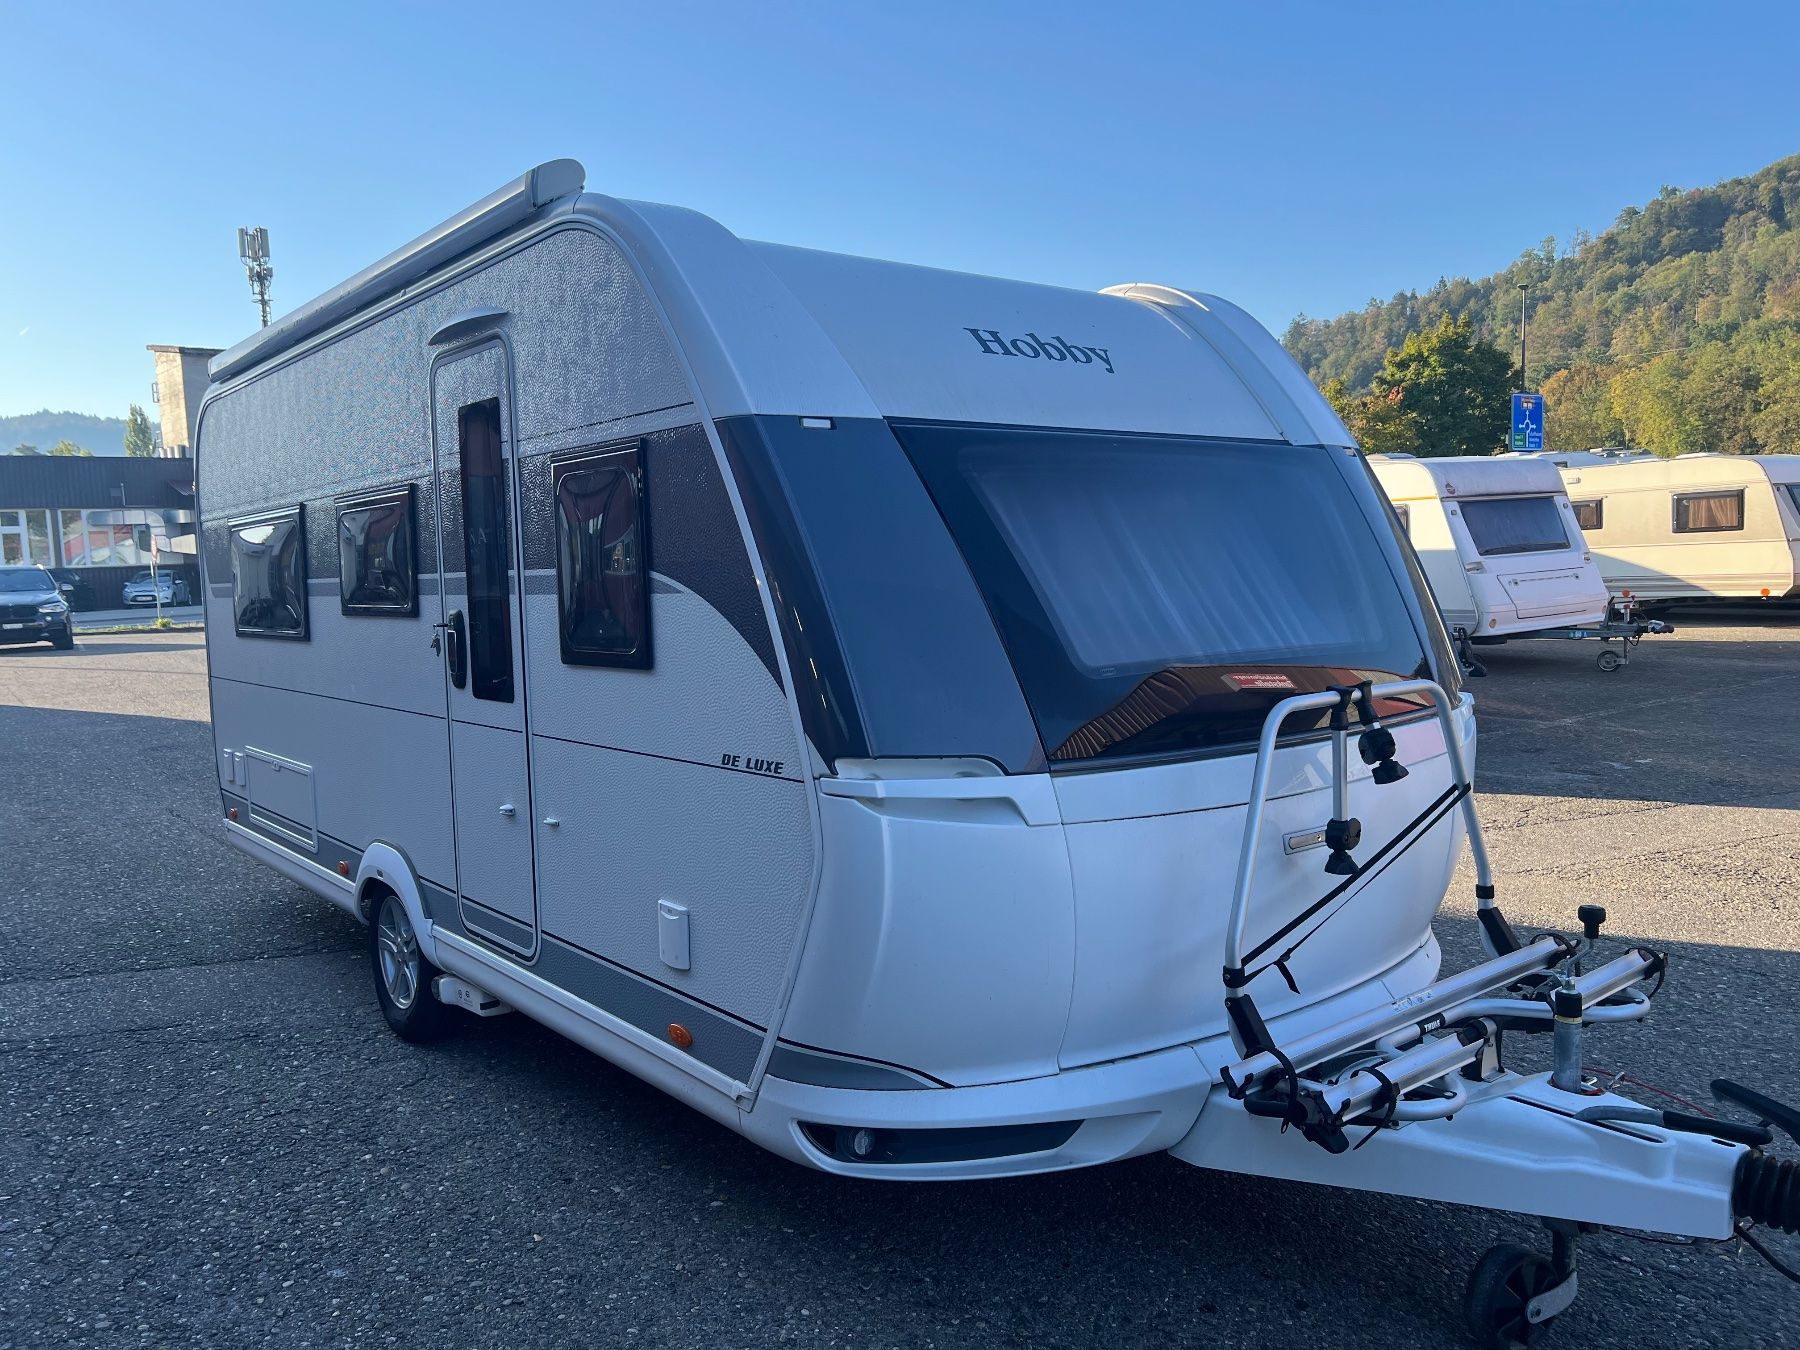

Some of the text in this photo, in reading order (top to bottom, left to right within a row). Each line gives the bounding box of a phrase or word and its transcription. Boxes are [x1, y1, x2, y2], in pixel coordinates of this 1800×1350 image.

[963, 327, 1115, 374] Hobby
[721, 753, 784, 775] DE LUXE
[1423, 1019, 1441, 1033] THULE
